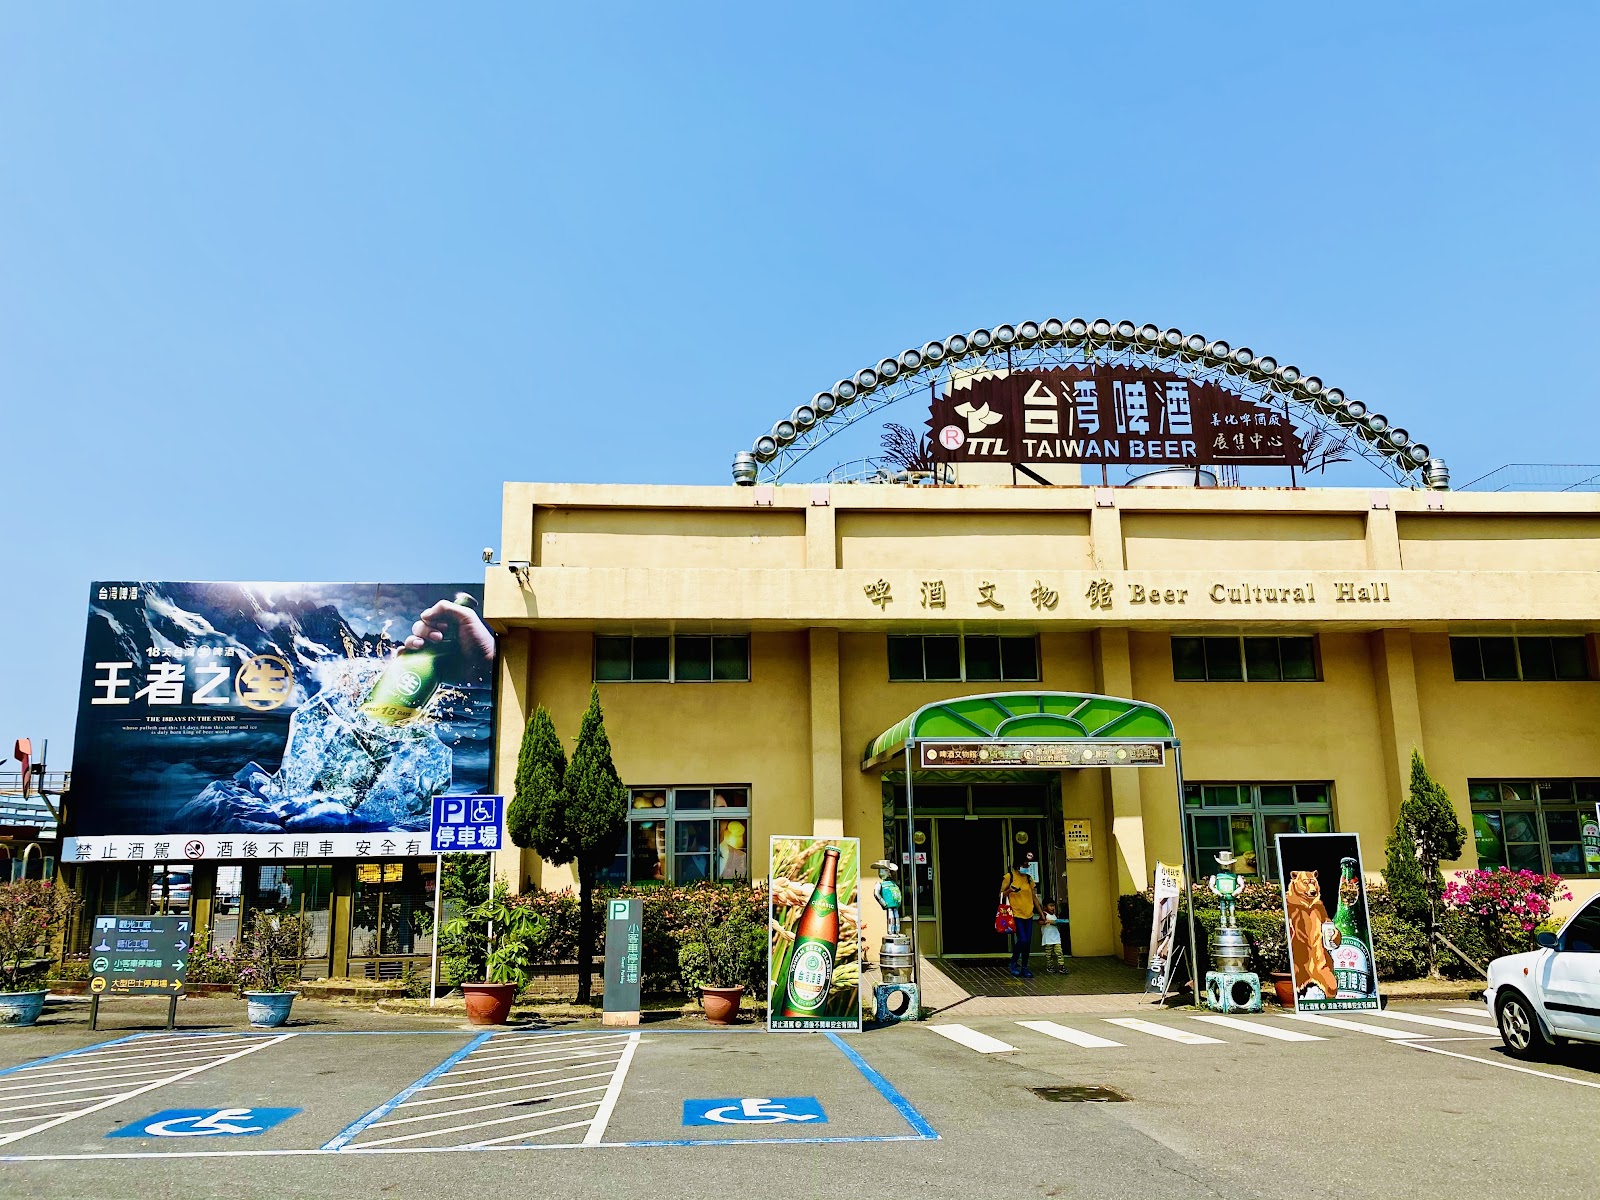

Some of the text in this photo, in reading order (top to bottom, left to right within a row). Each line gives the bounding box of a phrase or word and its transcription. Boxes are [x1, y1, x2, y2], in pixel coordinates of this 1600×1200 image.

[966, 437, 1010, 456] TTL
[1023, 439, 1196, 459] TAIWAN BEER
[1212, 432, 1284, 451] 展售中心
[863, 577, 1115, 612] 啤酒文物館
[1128, 582, 1391, 604] Beer Cultural Hall
[381, 706, 397, 716] 18
[443, 800, 463, 823] P
[435, 825, 499, 849] 停車場
[75, 841, 170, 860] 禁止酒駕
[216, 839, 334, 858] 酒後不開車
[613, 902, 627, 920] P
[113, 959, 162, 968] 小客車停車場
[111, 979, 168, 988] 大型巴士停車場
